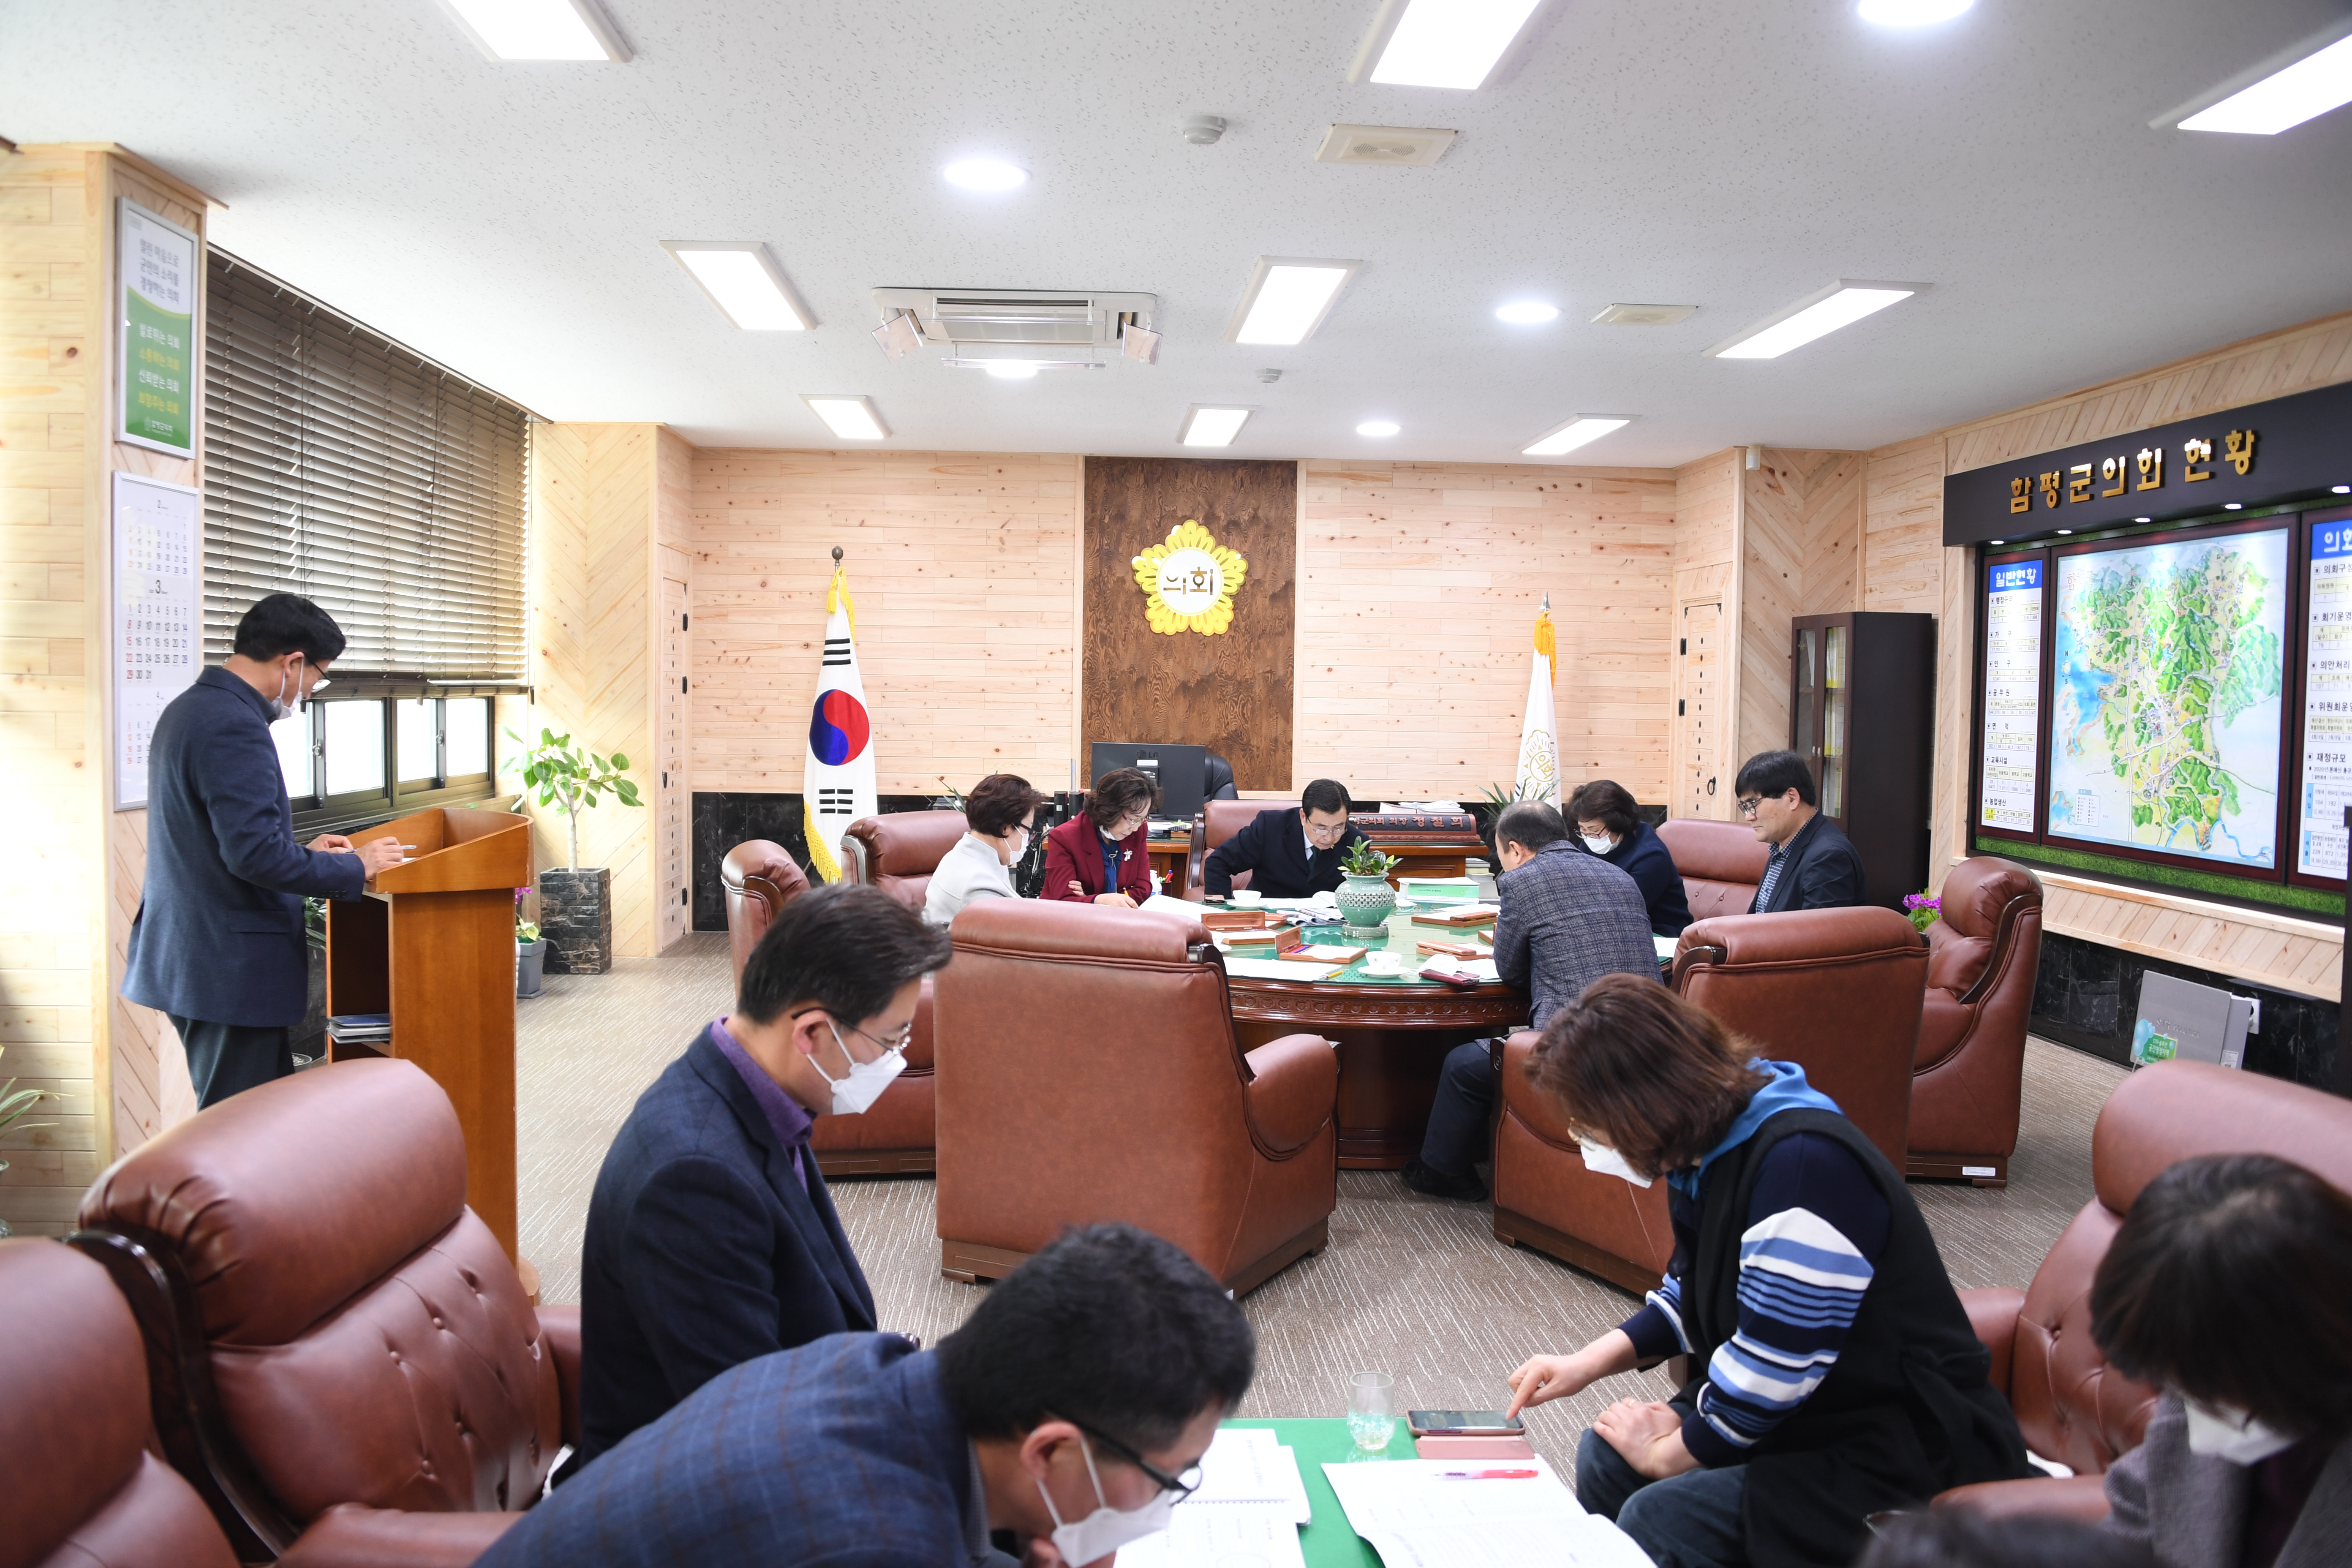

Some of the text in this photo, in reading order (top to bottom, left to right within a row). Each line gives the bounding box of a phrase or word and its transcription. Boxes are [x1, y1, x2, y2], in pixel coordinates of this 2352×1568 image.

[2010, 430, 2255, 513] 함평군의회 현황
[1163, 566, 1213, 595] 의회
[1996, 568, 2036, 588] 일반현황
[155, 580, 161, 594] 3
[129, 604, 186, 616] 1 2 3 4 5 6 7
[2322, 611, 2352, 622] 회기운영
[128, 620, 188, 632] 8 9 10 11 12 13 14
[126, 636, 187, 648] 15 16 17 18 19 20 21
[126, 653, 188, 664] 22 23 24 25 26 27 28
[2320, 660, 2349, 670] 의안처리
[127, 670, 151, 679] 29 30 31
[1991, 756, 2007, 765] 교육시설
[2317, 753, 2346, 762] 재정규모
[1990, 798, 2006, 806] 농업생산
[1389, 817, 1408, 825] 의장
